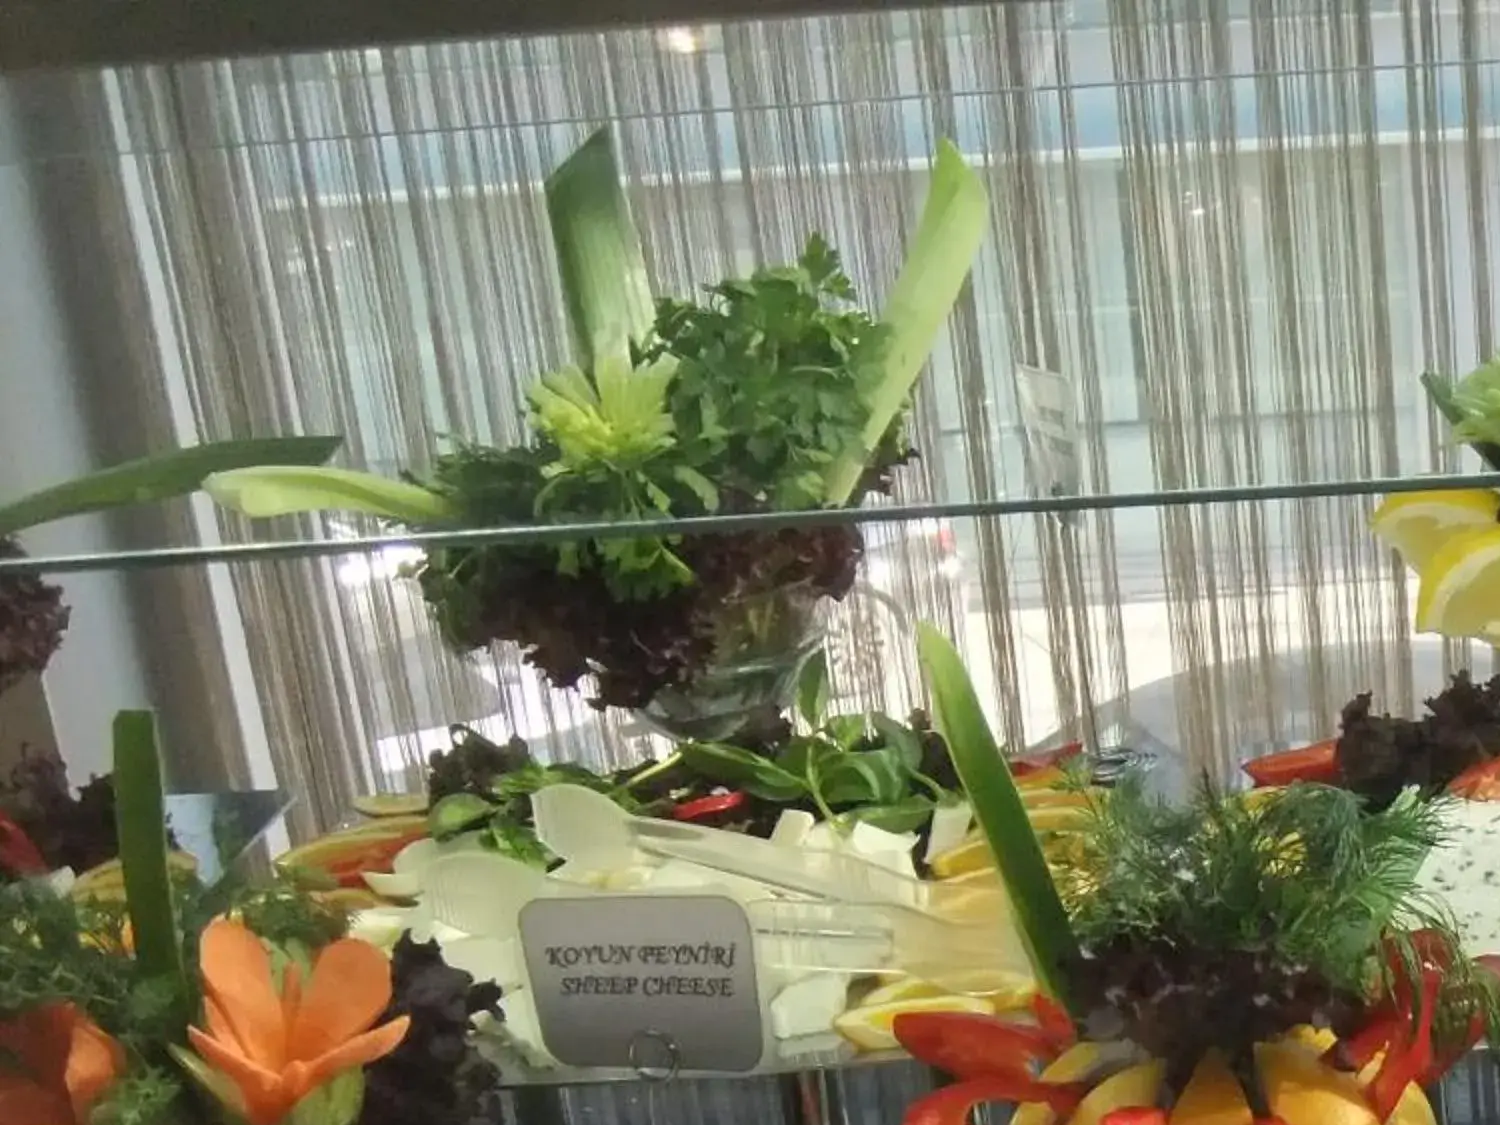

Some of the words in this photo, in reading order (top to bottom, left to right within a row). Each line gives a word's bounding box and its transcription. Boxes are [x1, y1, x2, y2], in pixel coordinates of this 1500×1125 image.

[545, 943, 634, 967] KOYUN
[637, 940, 735, 966] PEYNİRİ
[559, 975, 638, 995] SHEEP
[642, 975, 734, 996] CHEESE
